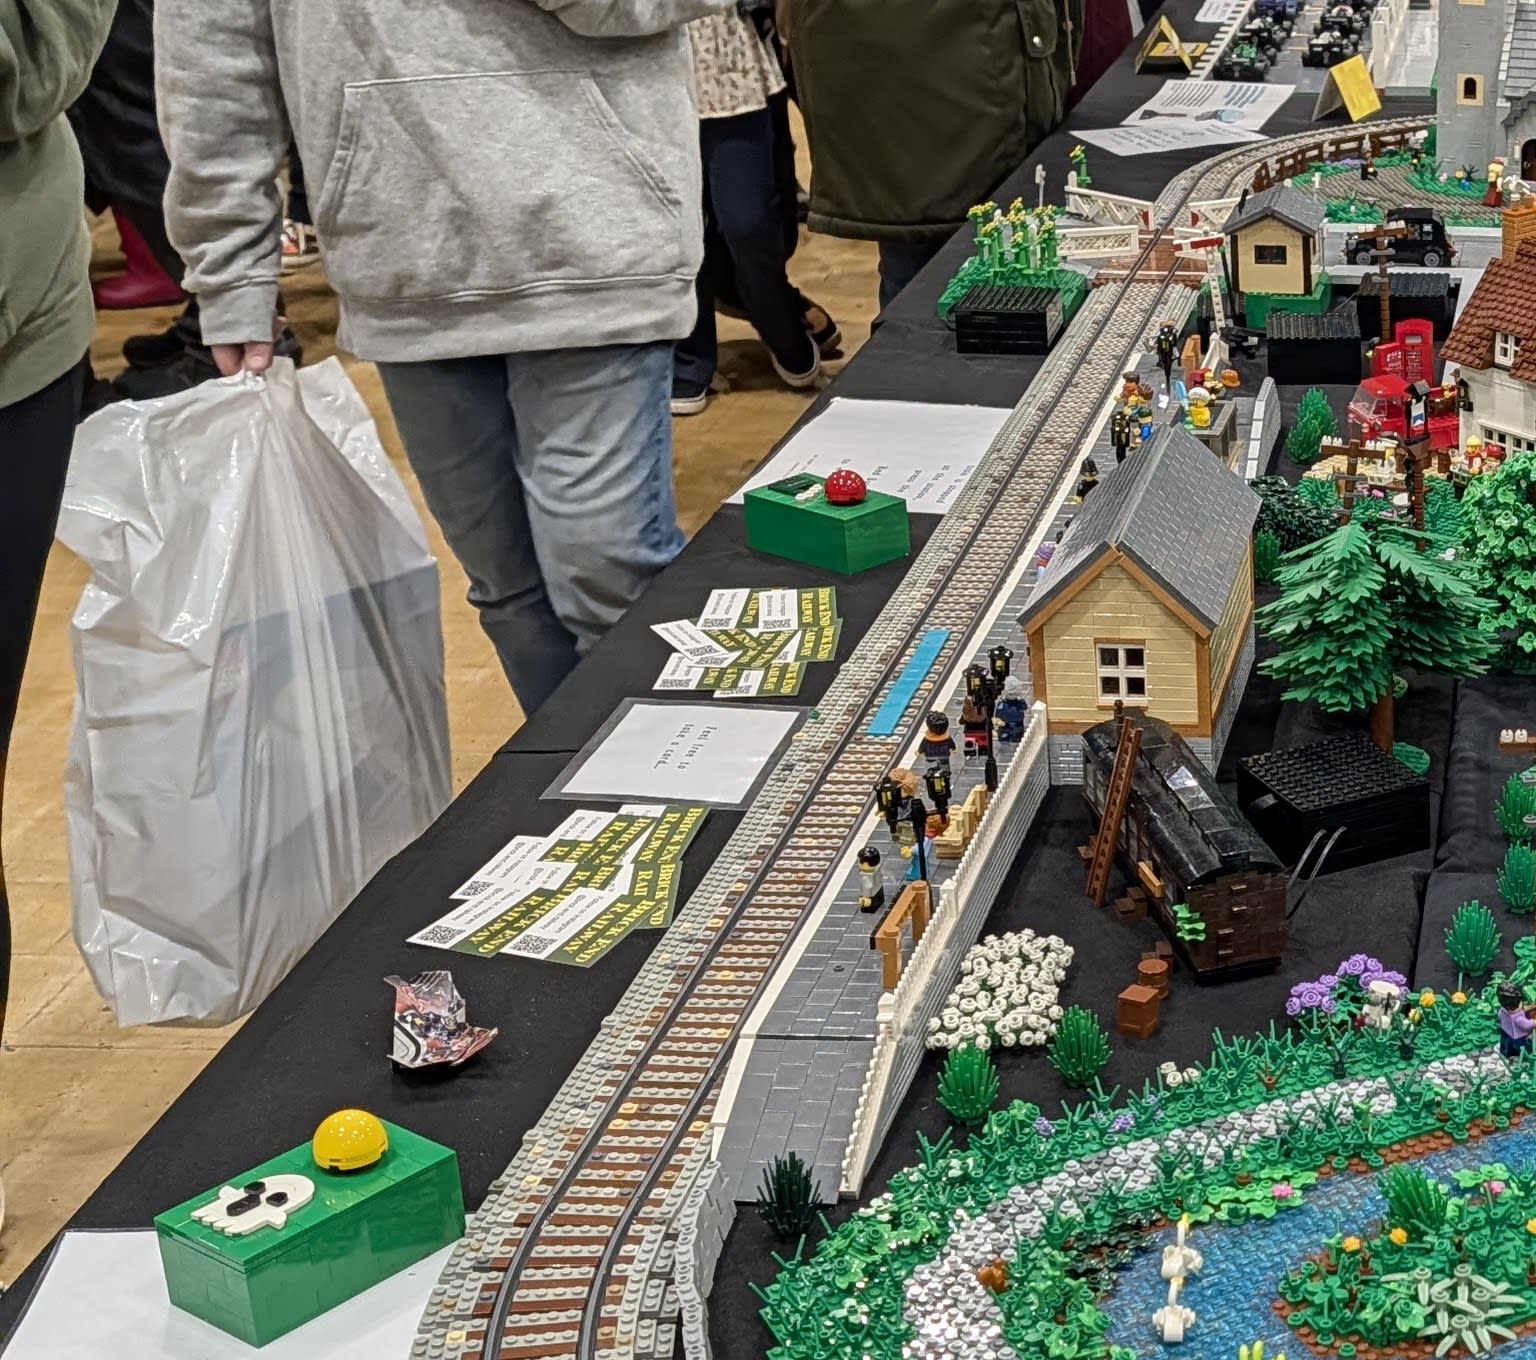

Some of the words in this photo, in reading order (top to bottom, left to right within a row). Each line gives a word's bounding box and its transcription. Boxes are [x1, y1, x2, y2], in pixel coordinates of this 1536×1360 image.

[638, 813, 681, 862] RAILWAY
[671, 808, 704, 843] BRICK
[655, 863, 676, 900] BRICK
[469, 895, 546, 944] RAILWAY
[563, 903, 631, 954] RAILWAY
[604, 900, 656, 937] BRICK
[478, 929, 516, 953] END
[575, 938, 613, 963] END
